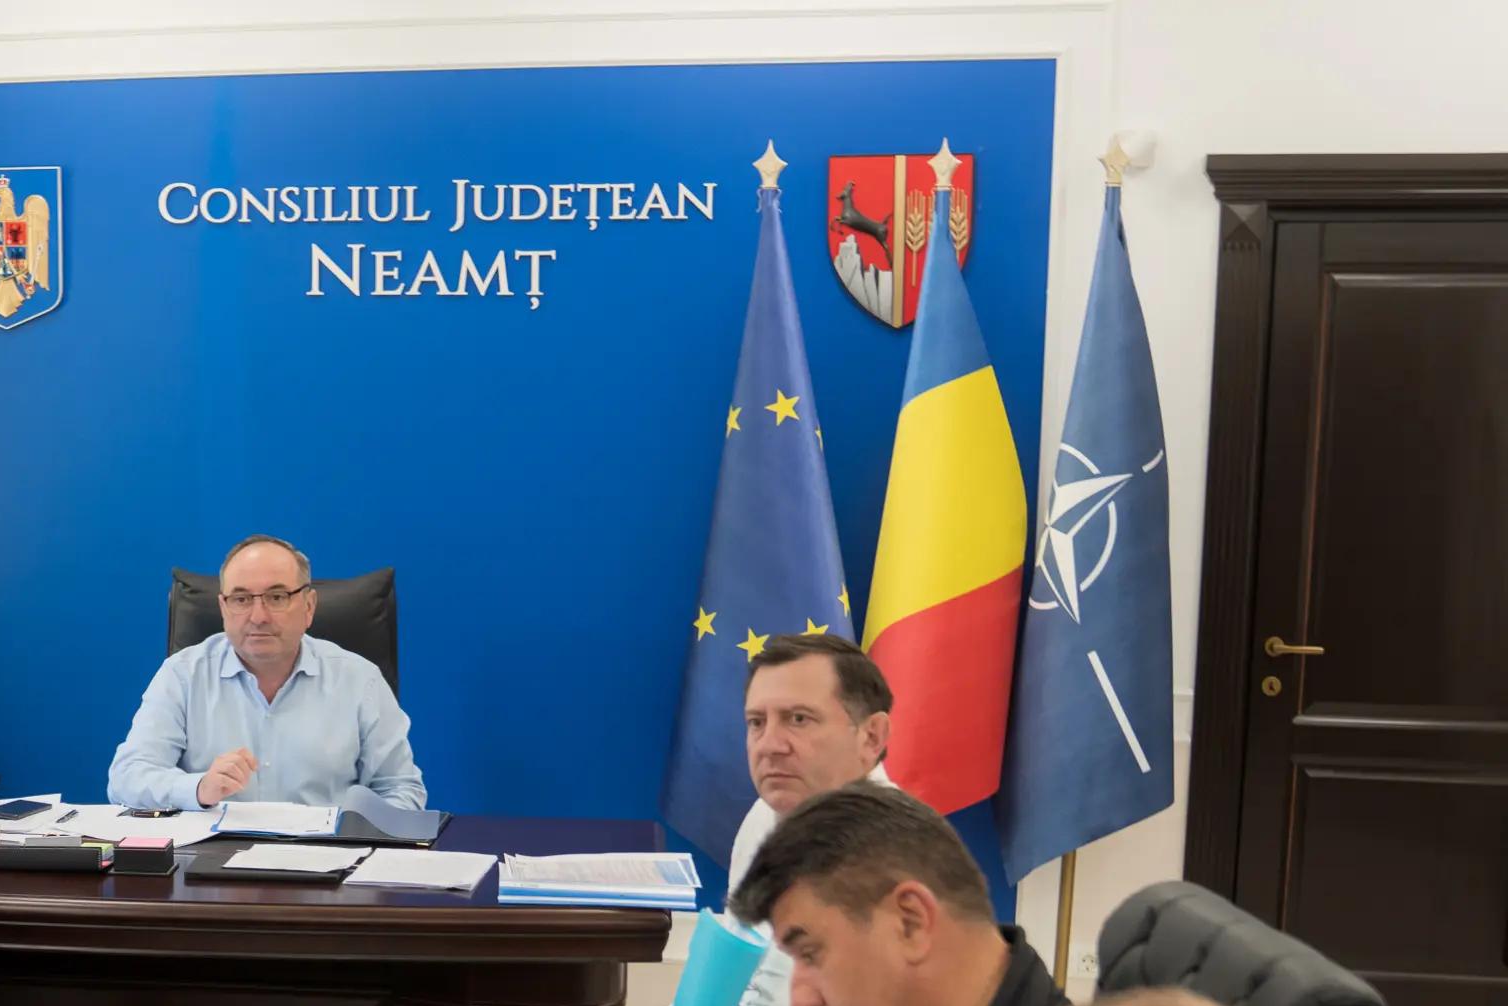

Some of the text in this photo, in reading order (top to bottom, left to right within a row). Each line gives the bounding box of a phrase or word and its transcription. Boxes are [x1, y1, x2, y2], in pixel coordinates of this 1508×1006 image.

[157, 178, 718, 232] CONSILIUL JUDEȚEAN
[305, 242, 557, 310] NEAMȚ
